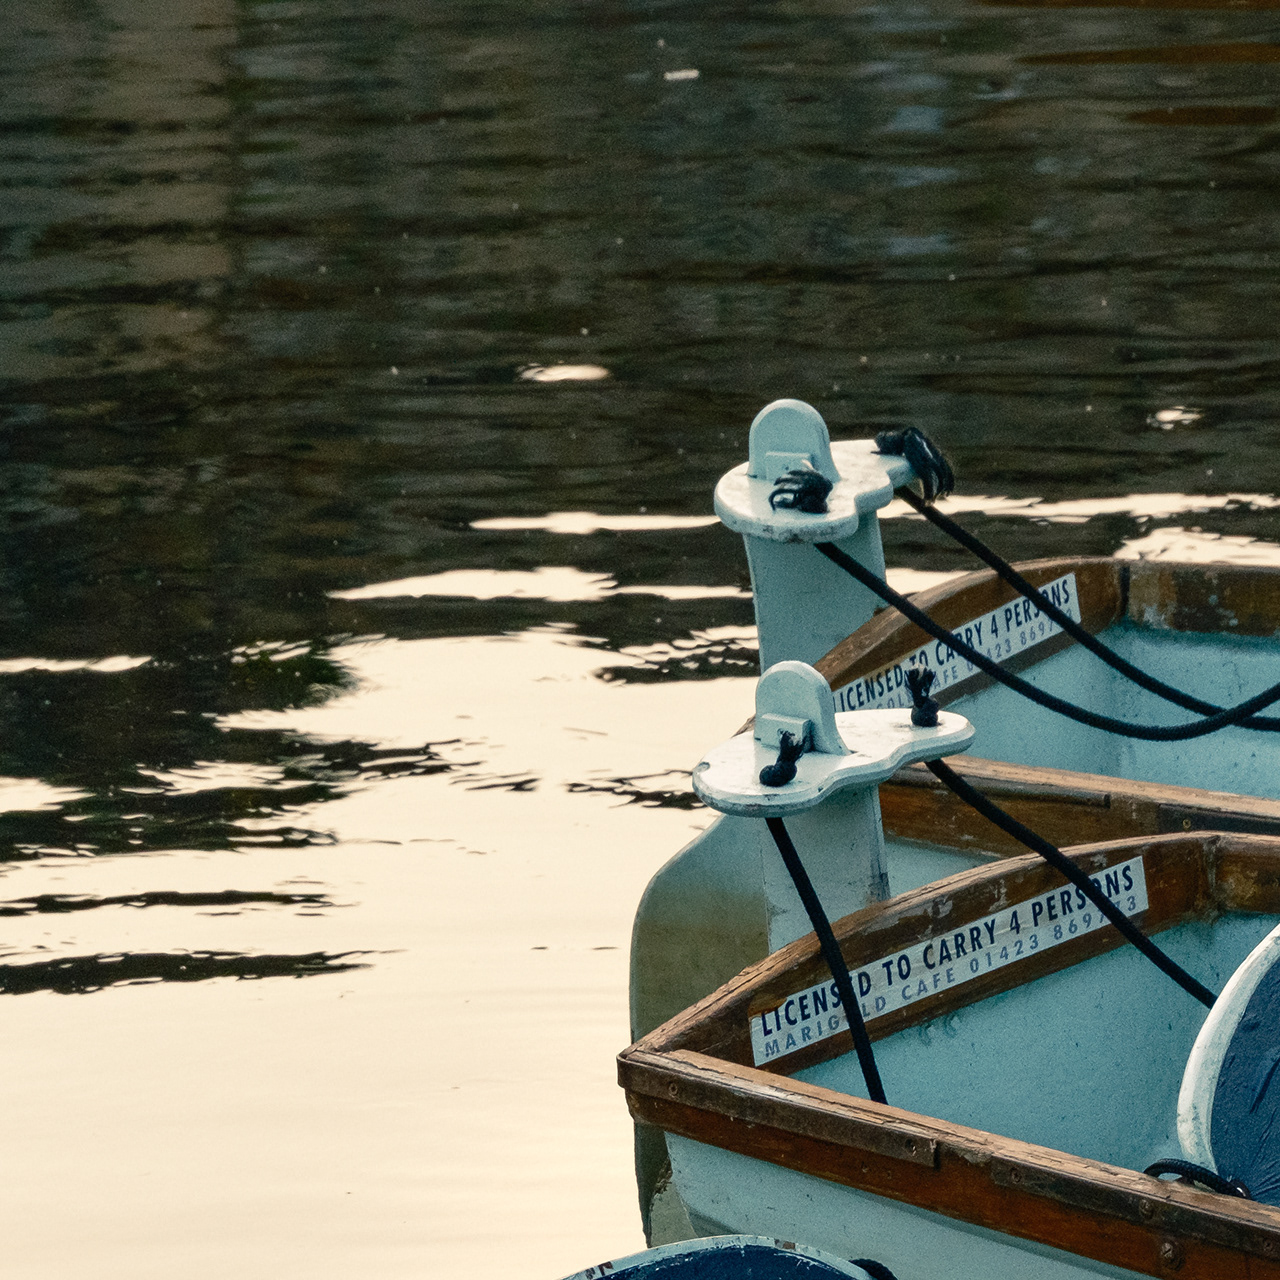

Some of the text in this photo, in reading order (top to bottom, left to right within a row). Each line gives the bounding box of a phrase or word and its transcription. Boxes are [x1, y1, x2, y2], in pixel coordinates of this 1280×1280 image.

[990, 614, 999, 638] 4
[761, 971, 872, 1037] LICENSD
[882, 951, 911, 986] TO
[923, 918, 997, 969] CARRY
[1009, 910, 1022, 936] 4
[764, 995, 887, 1058] MARIGLD
[901, 967, 956, 1001] CAFE
[969, 933, 1040, 975] 01423
